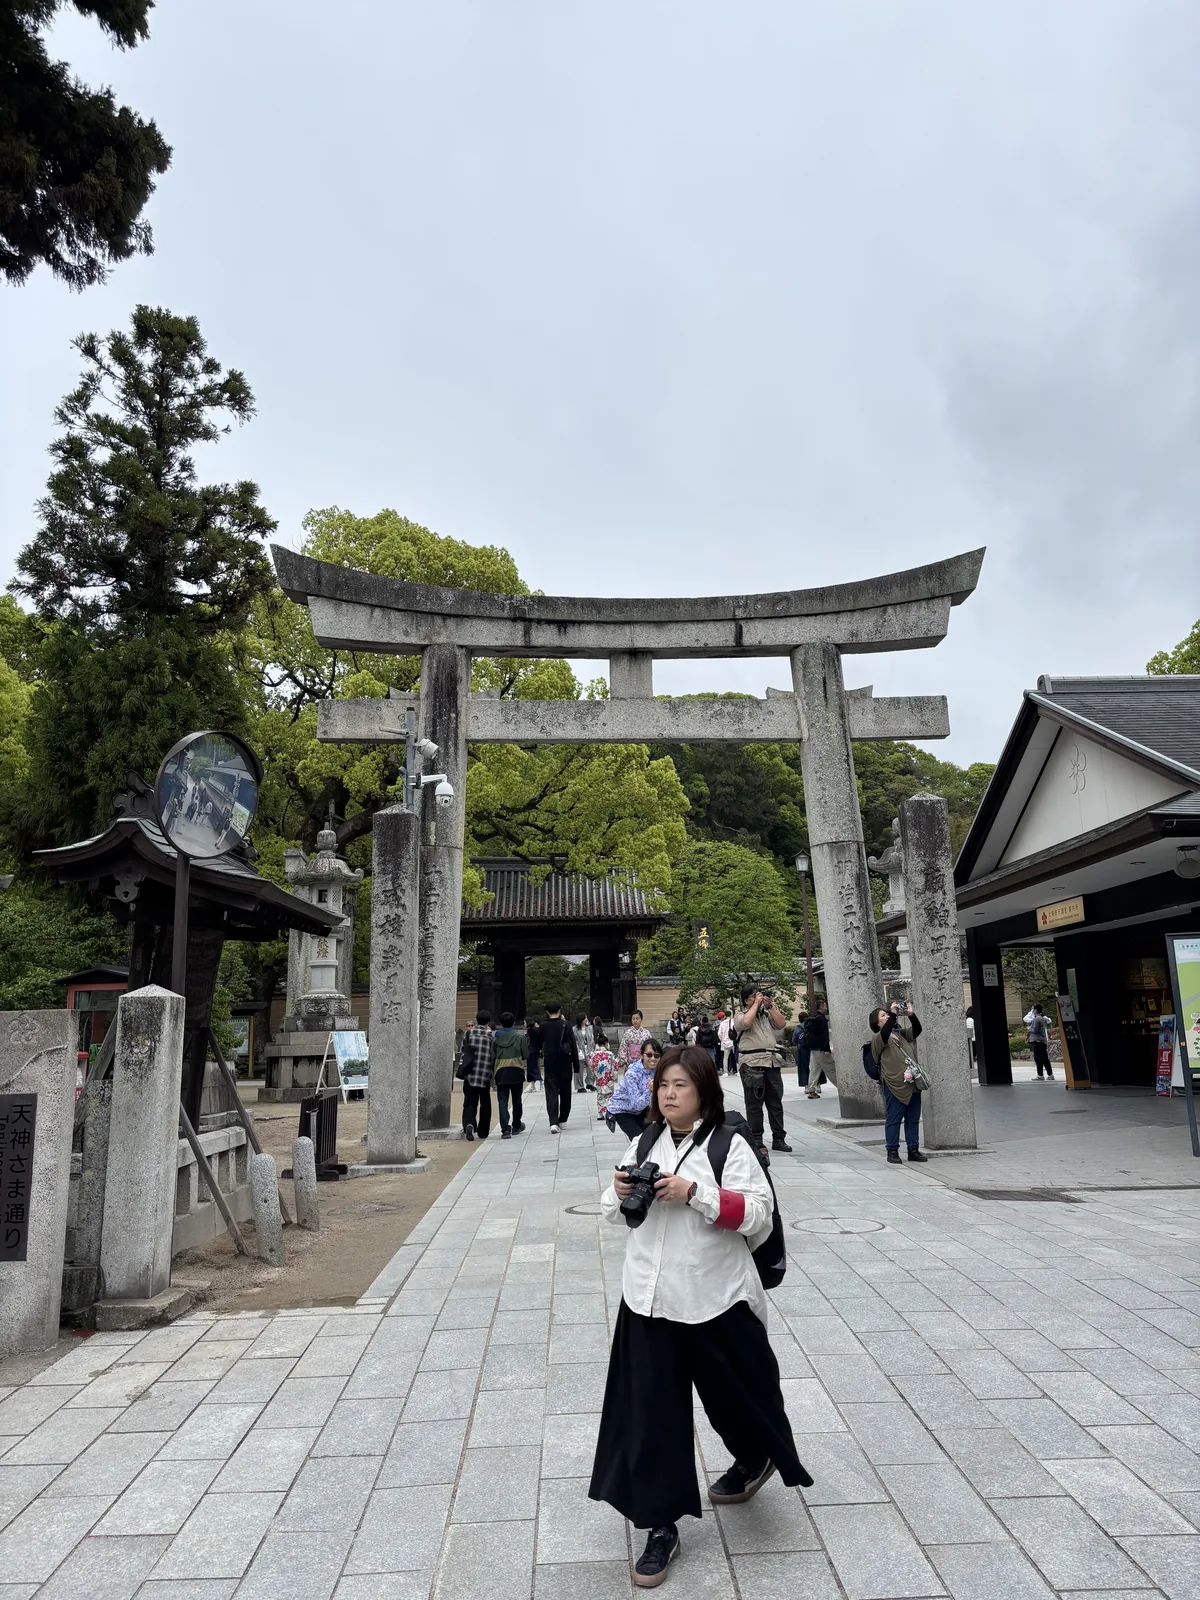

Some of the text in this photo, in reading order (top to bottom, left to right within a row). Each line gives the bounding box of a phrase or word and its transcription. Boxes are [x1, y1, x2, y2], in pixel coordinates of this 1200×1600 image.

[4, 1103, 33, 1249] 天神さま通り
